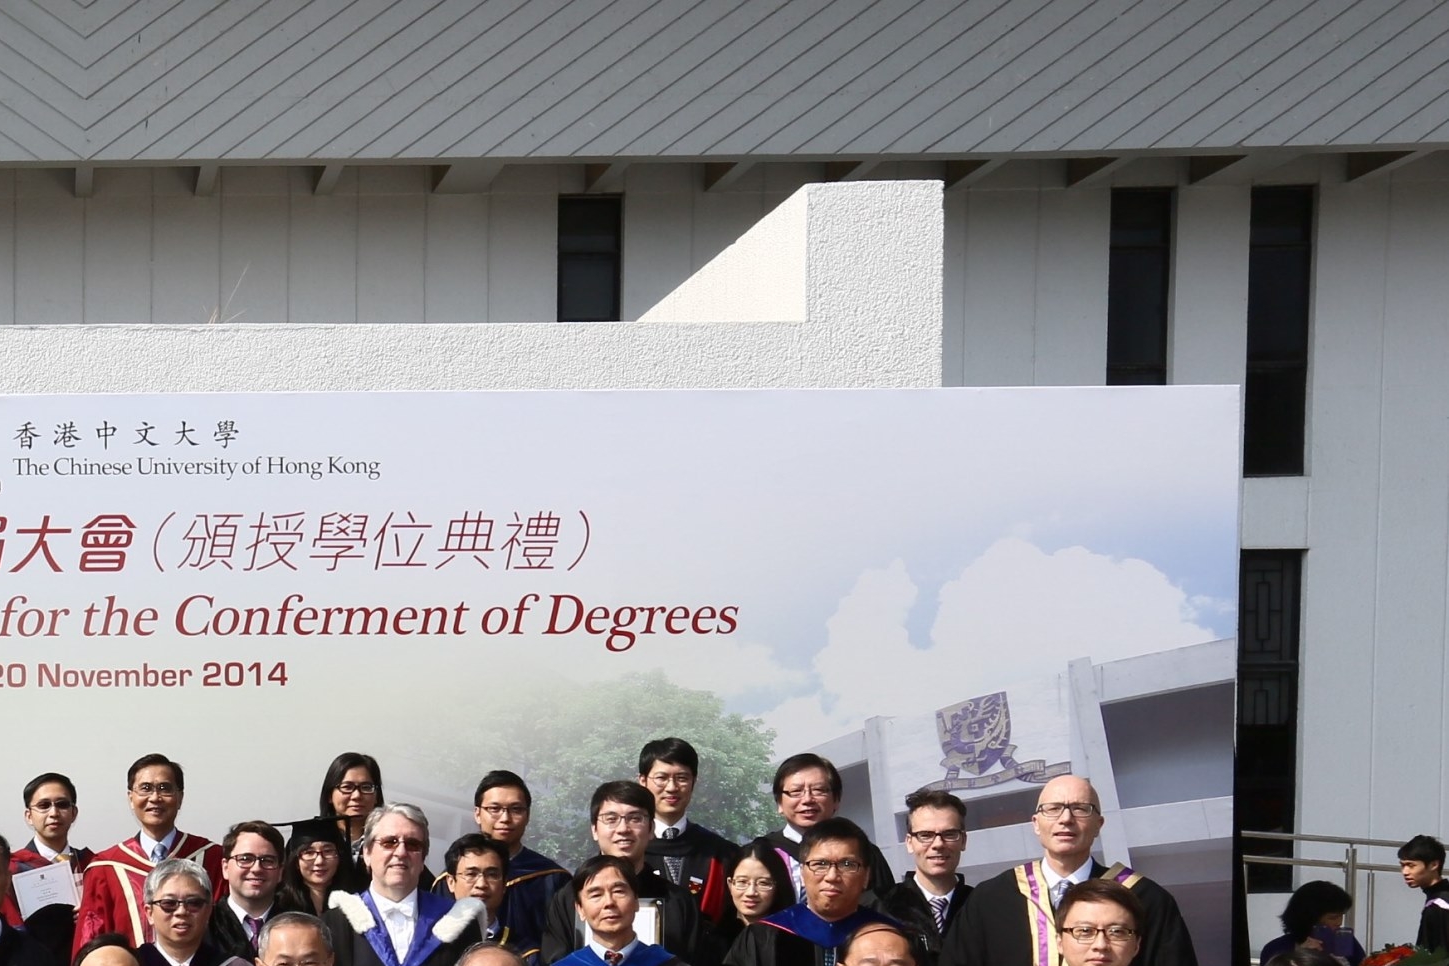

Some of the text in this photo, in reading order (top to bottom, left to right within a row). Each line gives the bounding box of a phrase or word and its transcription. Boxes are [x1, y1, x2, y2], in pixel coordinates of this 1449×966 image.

[12, 419, 240, 451] 香港中文大學
[12, 455, 382, 481] The Chinese University of Hong Kong
[82, 594, 159, 638] the
[174, 593, 471, 637] Conferment
[480, 593, 540, 637] of
[542, 594, 739, 653] Degrees
[37, 662, 194, 688] November
[202, 661, 289, 688] 2014
